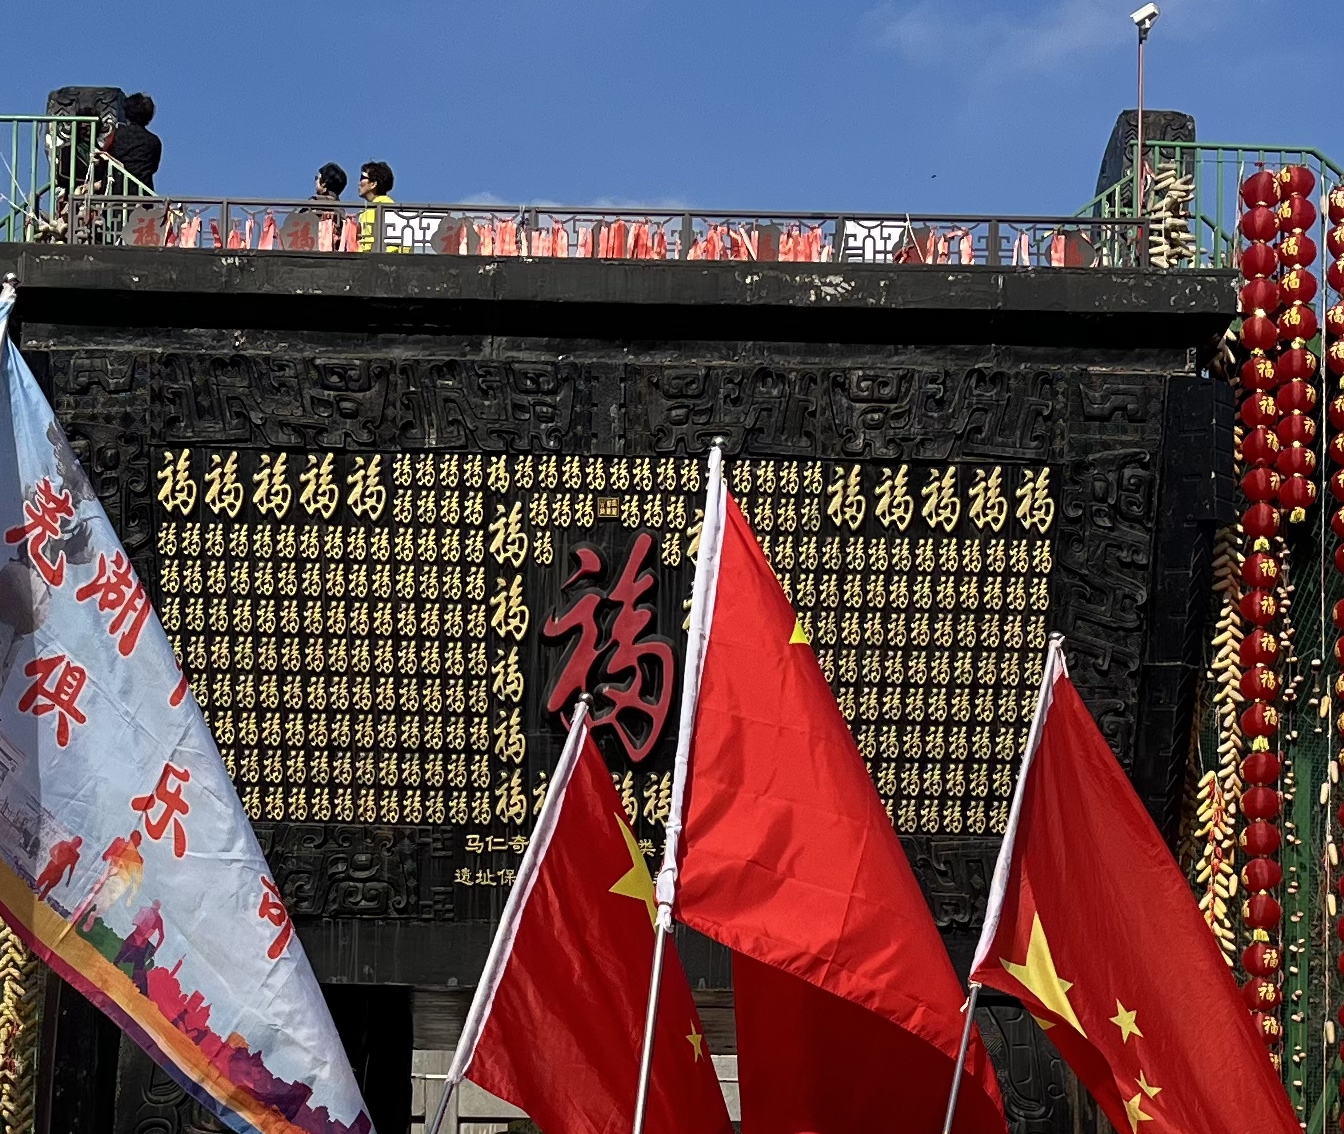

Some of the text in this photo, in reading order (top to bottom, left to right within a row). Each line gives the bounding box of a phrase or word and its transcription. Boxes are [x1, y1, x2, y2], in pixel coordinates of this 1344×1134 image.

[1282, 270, 1302, 291] 福
[1283, 305, 1302, 326] 福
[1259, 396, 1276, 415] 福
[1258, 558, 1277, 577] 福
[1259, 596, 1275, 615] 福
[542, 533, 676, 762] 福
[1257, 633, 1276, 652] 福
[1260, 670, 1275, 690] 福
[1258, 982, 1275, 1002] 福
